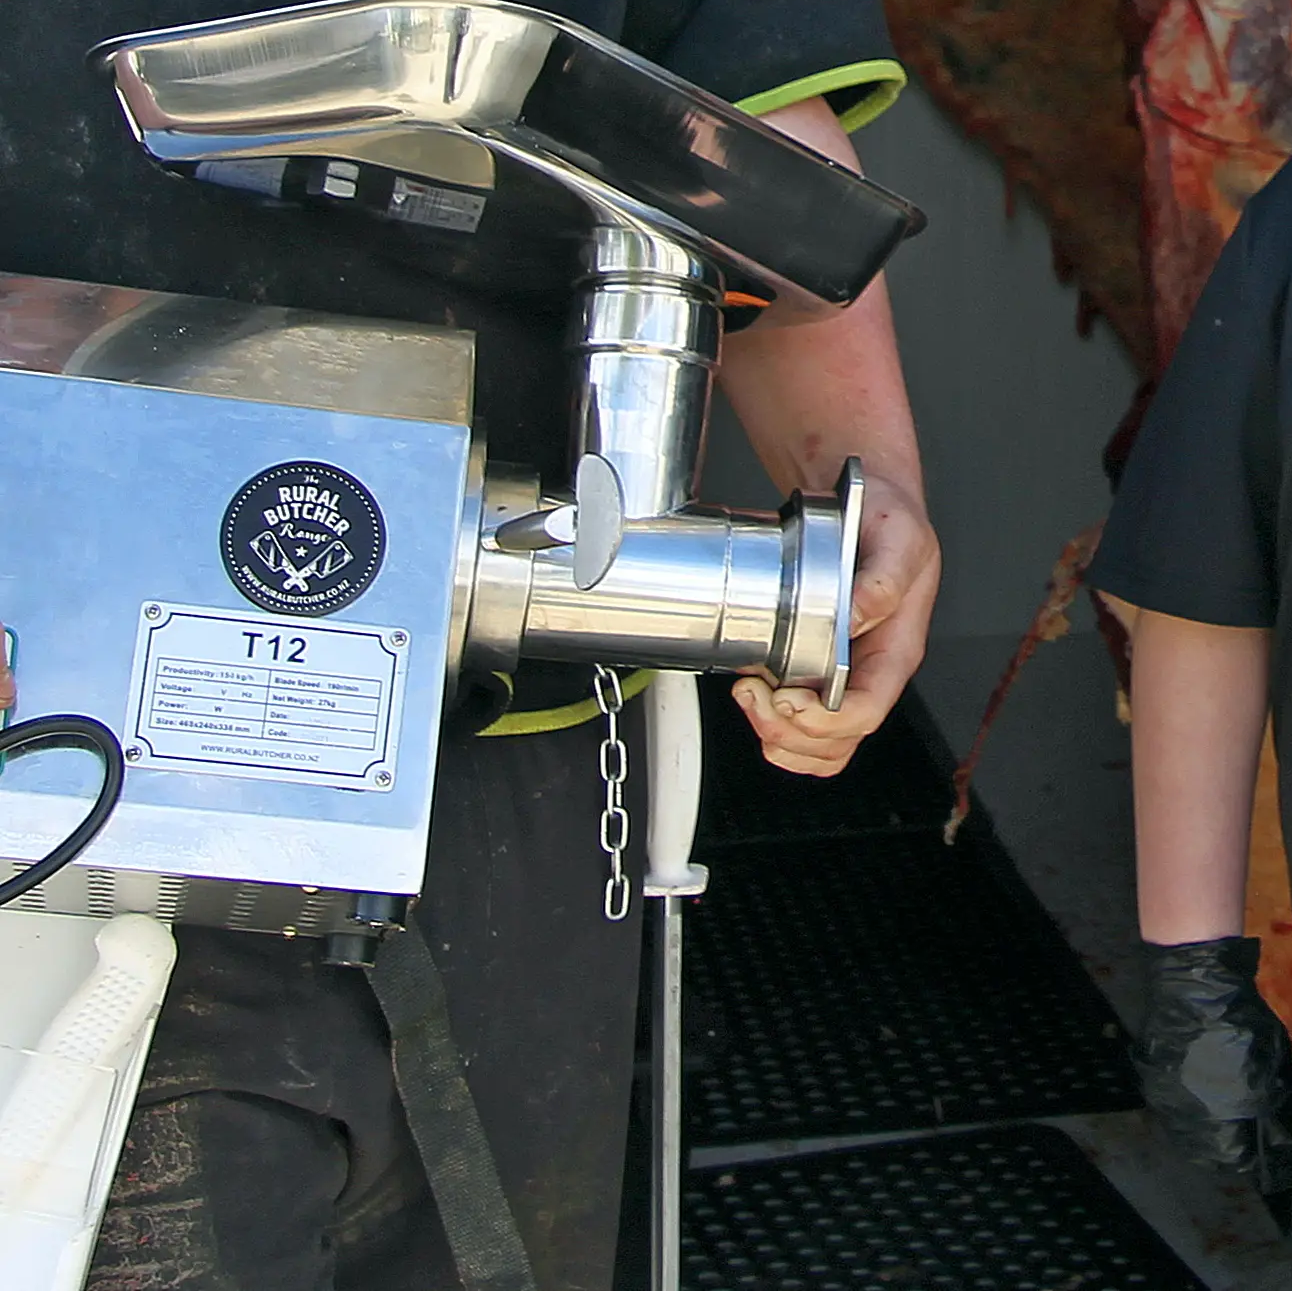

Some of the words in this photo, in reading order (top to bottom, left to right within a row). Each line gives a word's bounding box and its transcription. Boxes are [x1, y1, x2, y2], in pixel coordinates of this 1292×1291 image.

[278, 485, 340, 510] RURAL
[263, 502, 351, 537] BUTCHER
[279, 522, 333, 546] Range
[242, 631, 307, 664] T12
[221, 688, 228, 697] V
